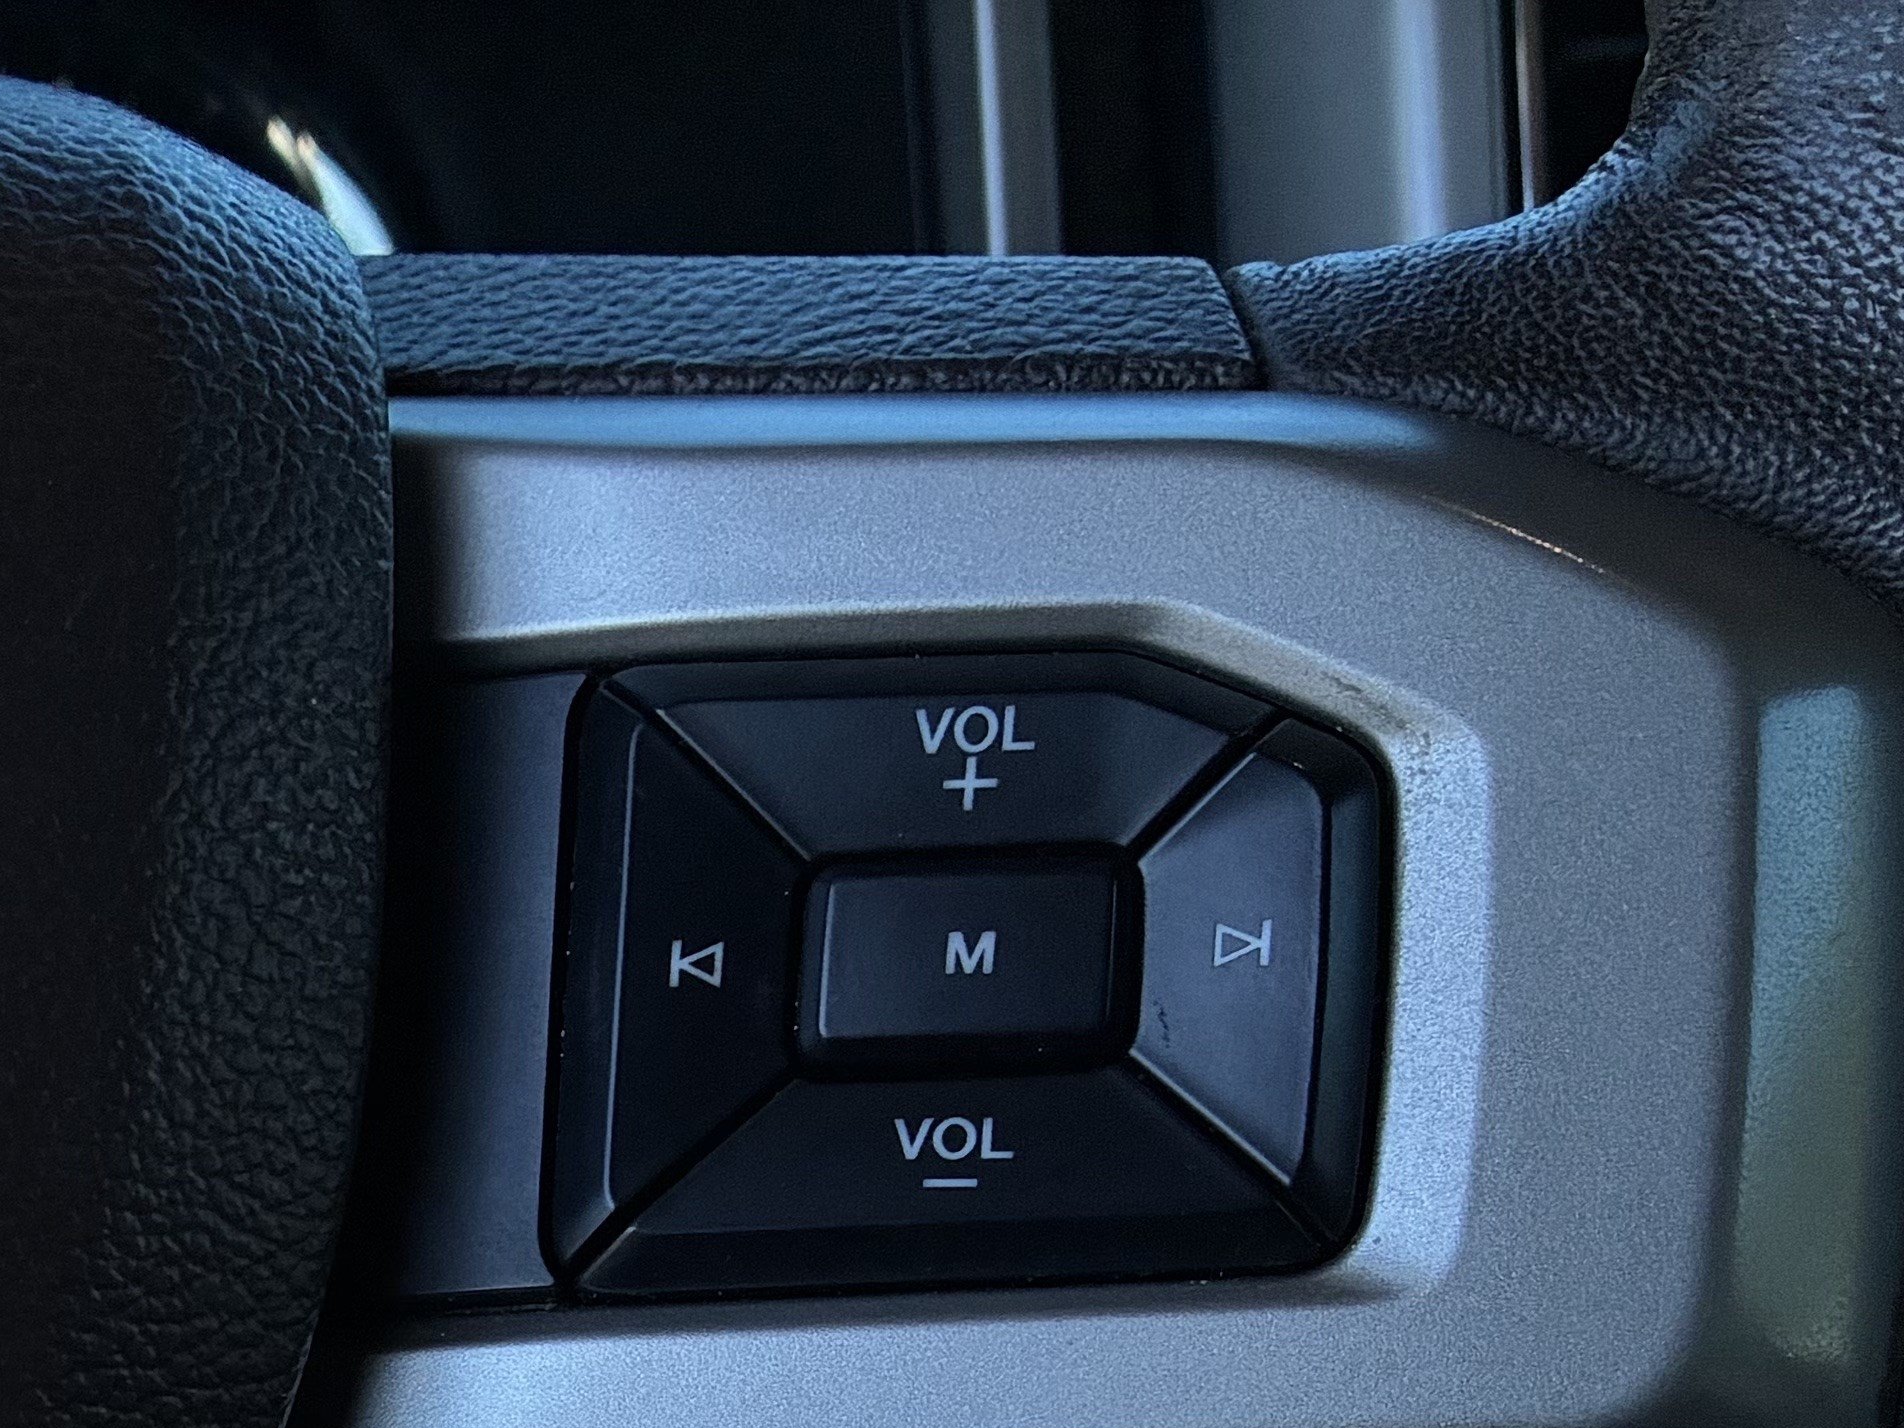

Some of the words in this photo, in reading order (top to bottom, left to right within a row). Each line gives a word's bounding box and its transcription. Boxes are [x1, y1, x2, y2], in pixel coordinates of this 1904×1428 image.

[915, 705, 1035, 754] VOL
[944, 931, 996, 975] M
[894, 1117, 1014, 1162] VOL
